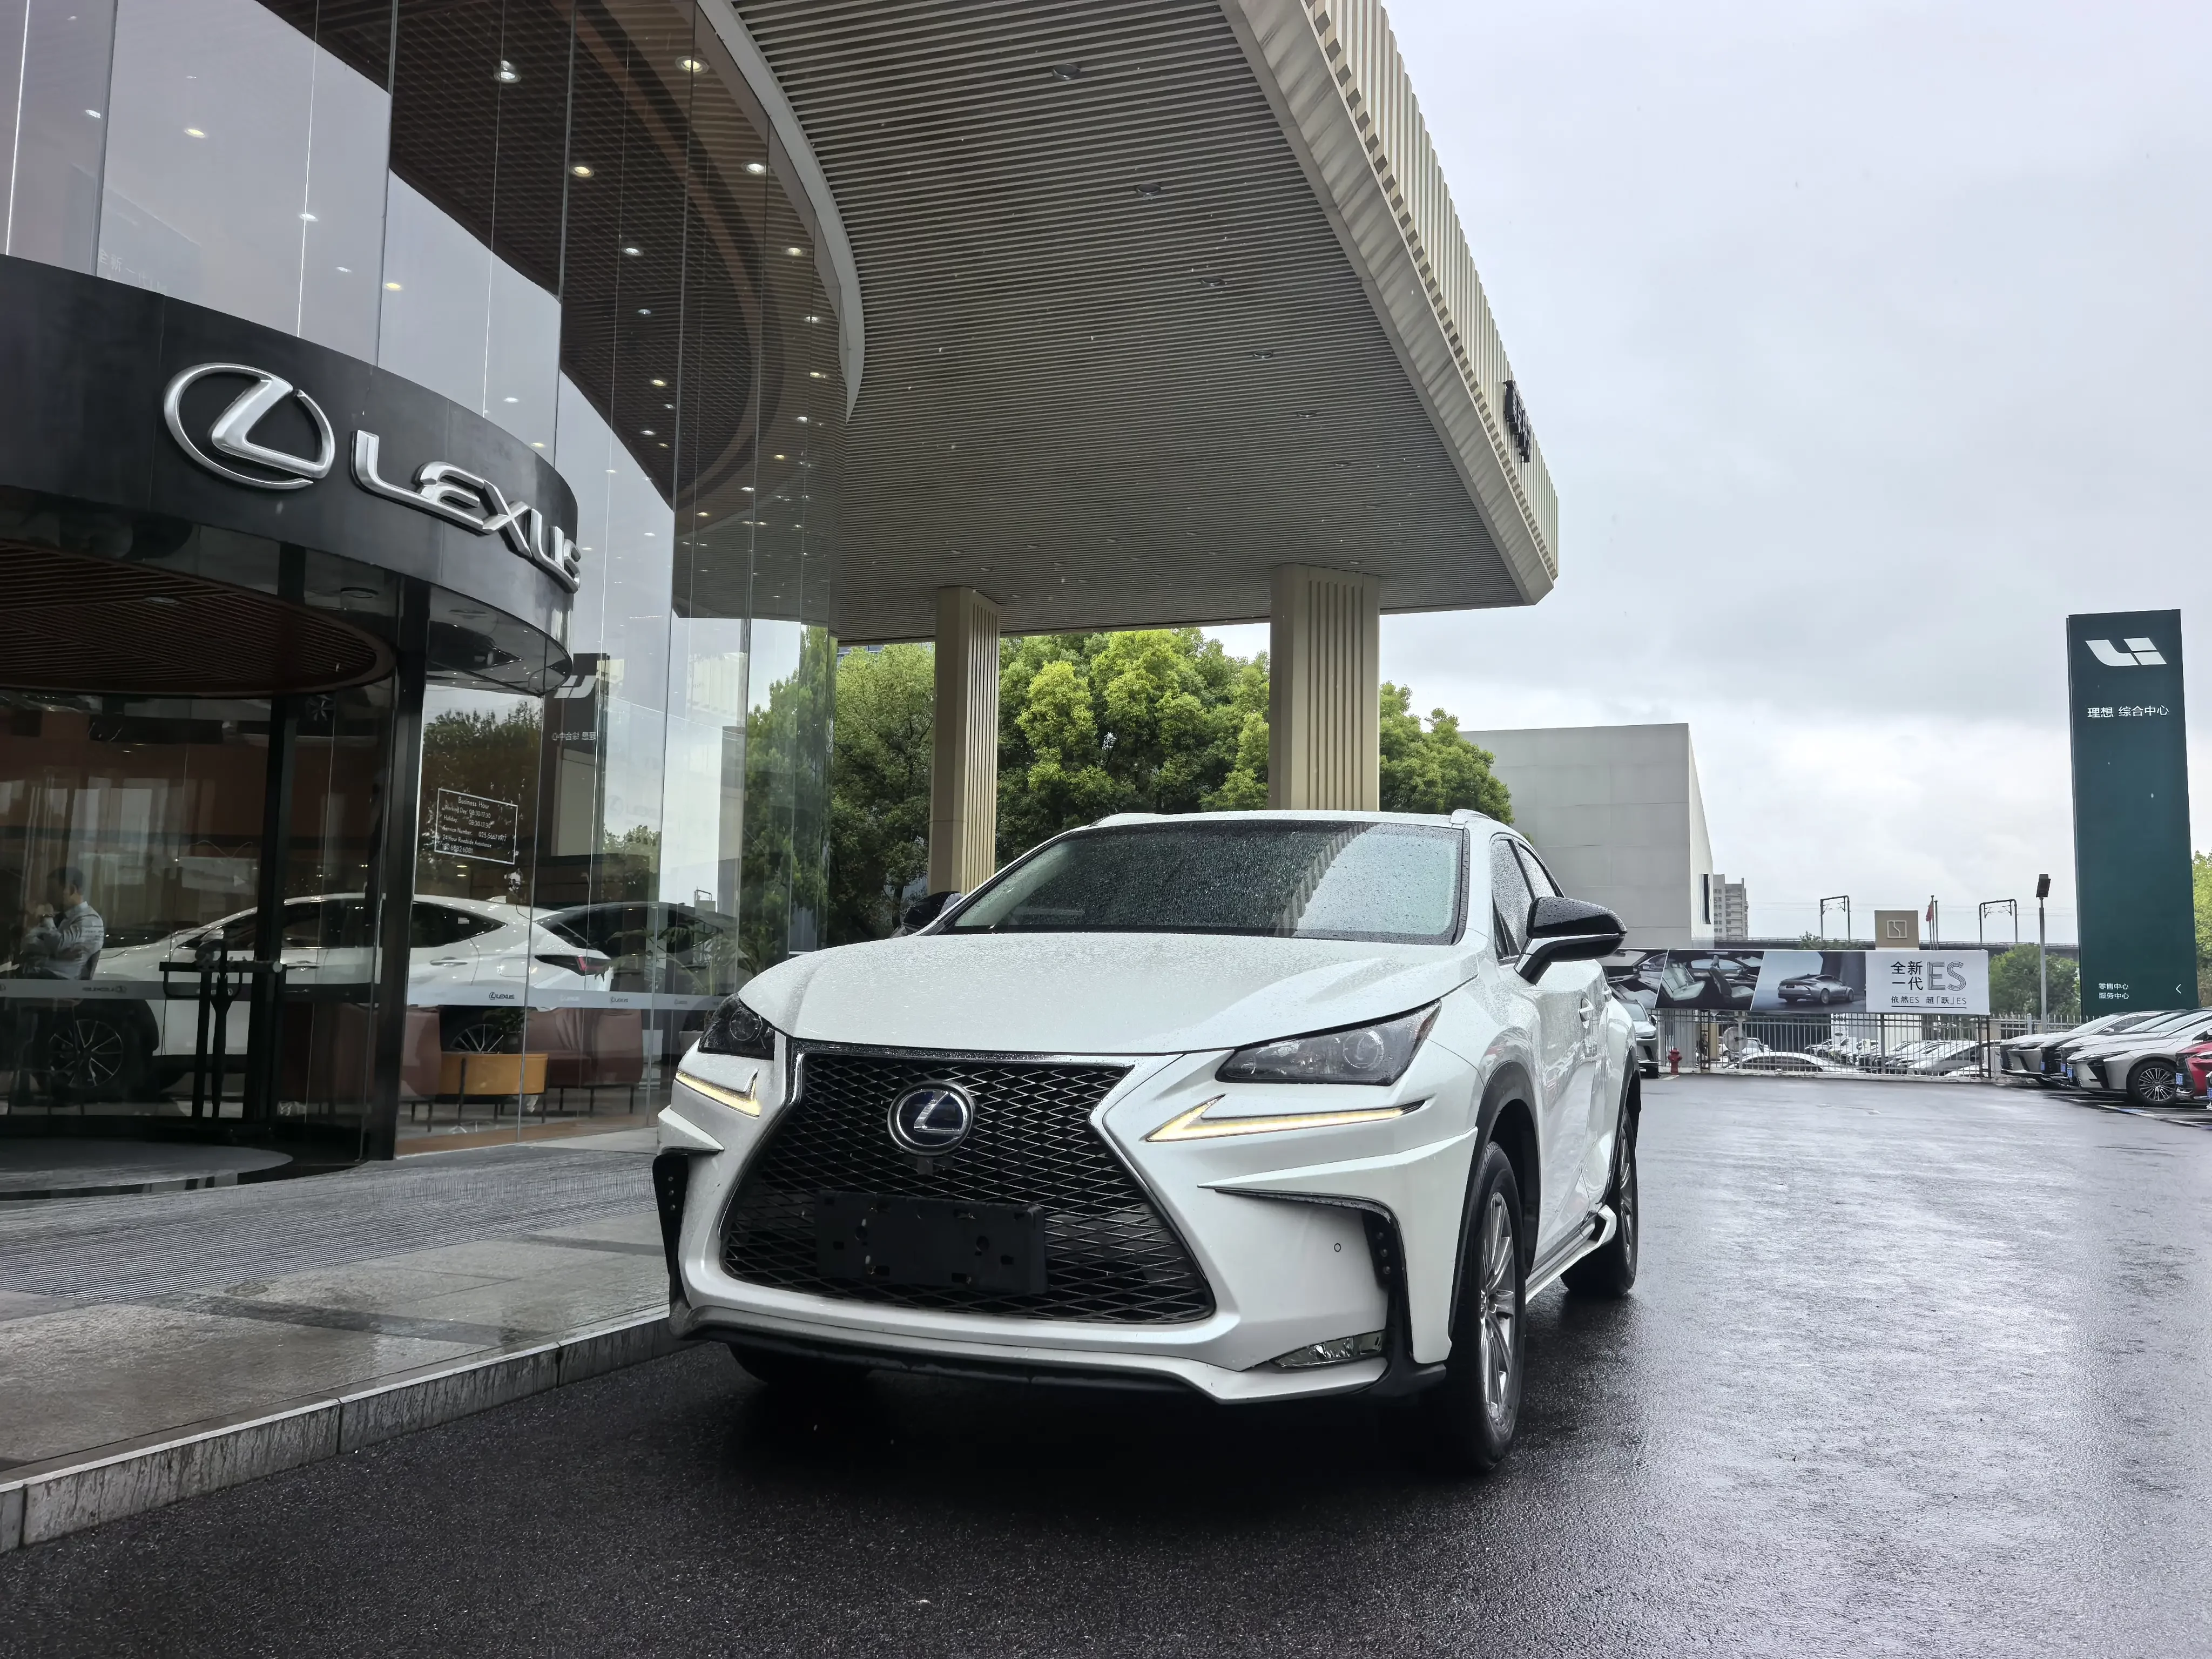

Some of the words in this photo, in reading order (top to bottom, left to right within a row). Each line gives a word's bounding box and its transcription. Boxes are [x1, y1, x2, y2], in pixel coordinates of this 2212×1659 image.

[352, 429, 582, 594] LEXUS
[2087, 707, 2114, 718] 理想
[2118, 705, 2169, 717] 综合中心
[458, 796, 477, 807] Business
[478, 800, 490, 810] Hour
[1891, 961, 1923, 975] 全新
[1892, 976, 1923, 990] 一代
[1927, 961, 1966, 991] ES
